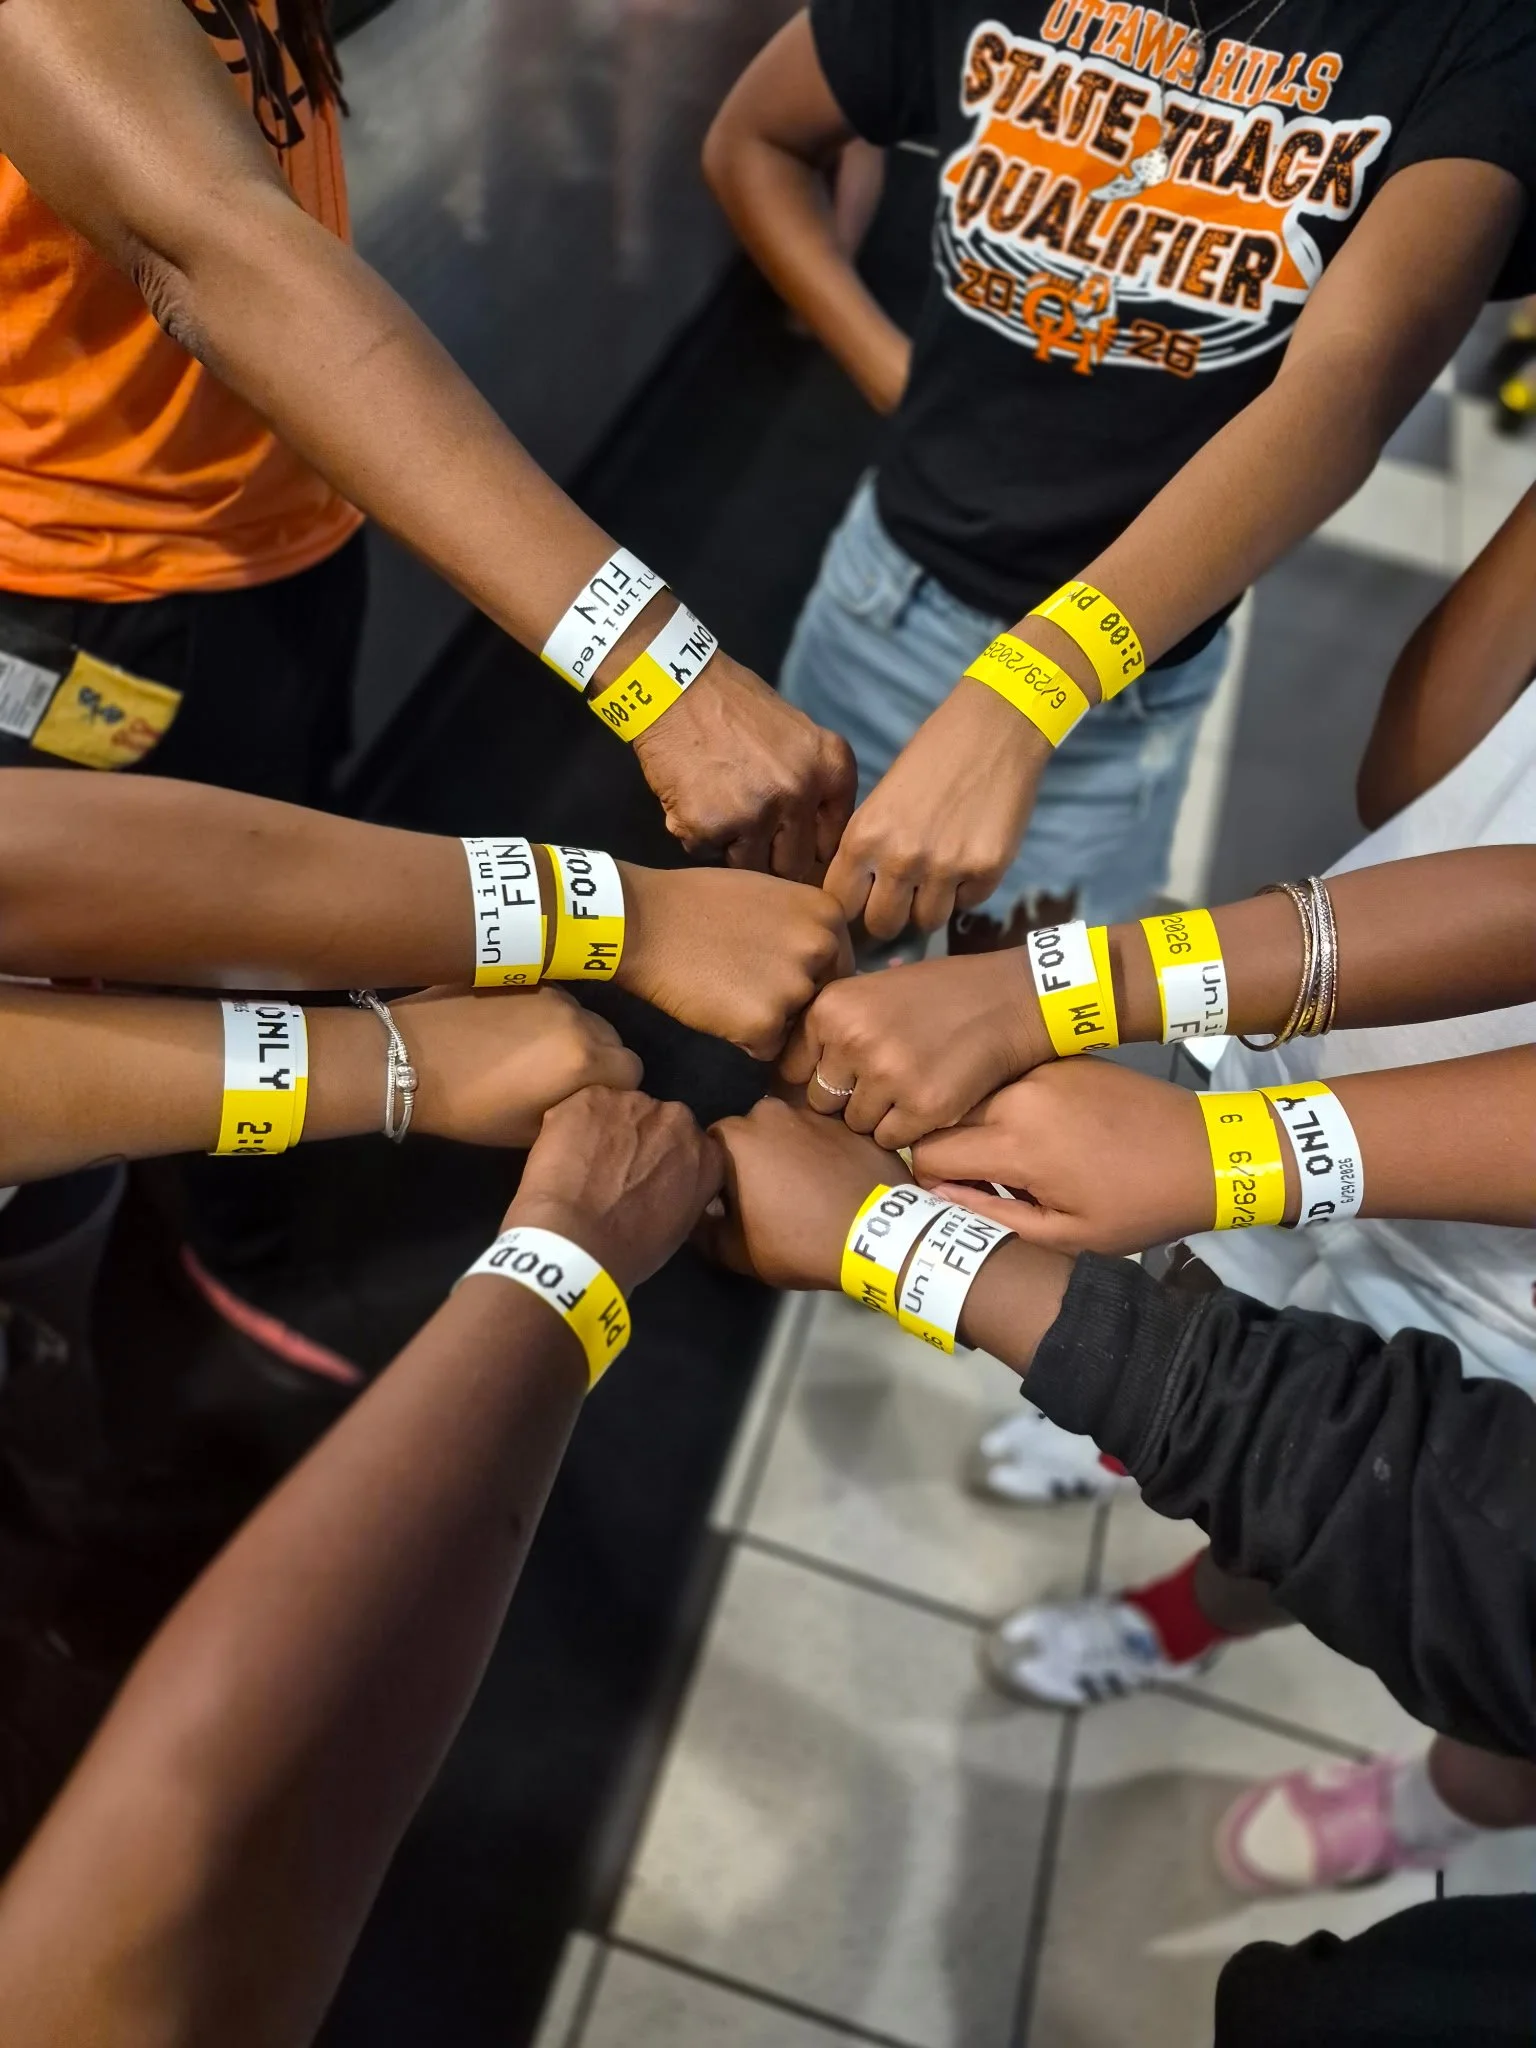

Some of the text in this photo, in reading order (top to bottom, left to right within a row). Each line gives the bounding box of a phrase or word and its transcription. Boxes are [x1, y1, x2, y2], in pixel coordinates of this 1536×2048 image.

[1200, 38, 1343, 113] HILLS
[963, 31, 1382, 209] STATE TRACK
[955, 147, 1278, 311] QUALIFIER
[1126, 318, 1202, 379] 26
[574, 561, 632, 625] FUN
[669, 625, 714, 686] ONLY
[1100, 613, 1142, 675] 2:00
[601, 680, 652, 727] 2:00
[493, 845, 536, 907] FUN
[560, 846, 600, 920] FOOD
[583, 942, 618, 971] PM
[255, 1006, 290, 1090] ONLY
[1068, 1002, 1104, 1036] PM
[1276, 1096, 1334, 1176] ONLY
[1338, 1157, 1356, 1204] 6/29/2026
[853, 1189, 919, 1264] FOOD
[943, 1218, 1002, 1276] FUN
[489, 1247, 587, 1312] FOOD
[597, 1298, 627, 1348] PM
